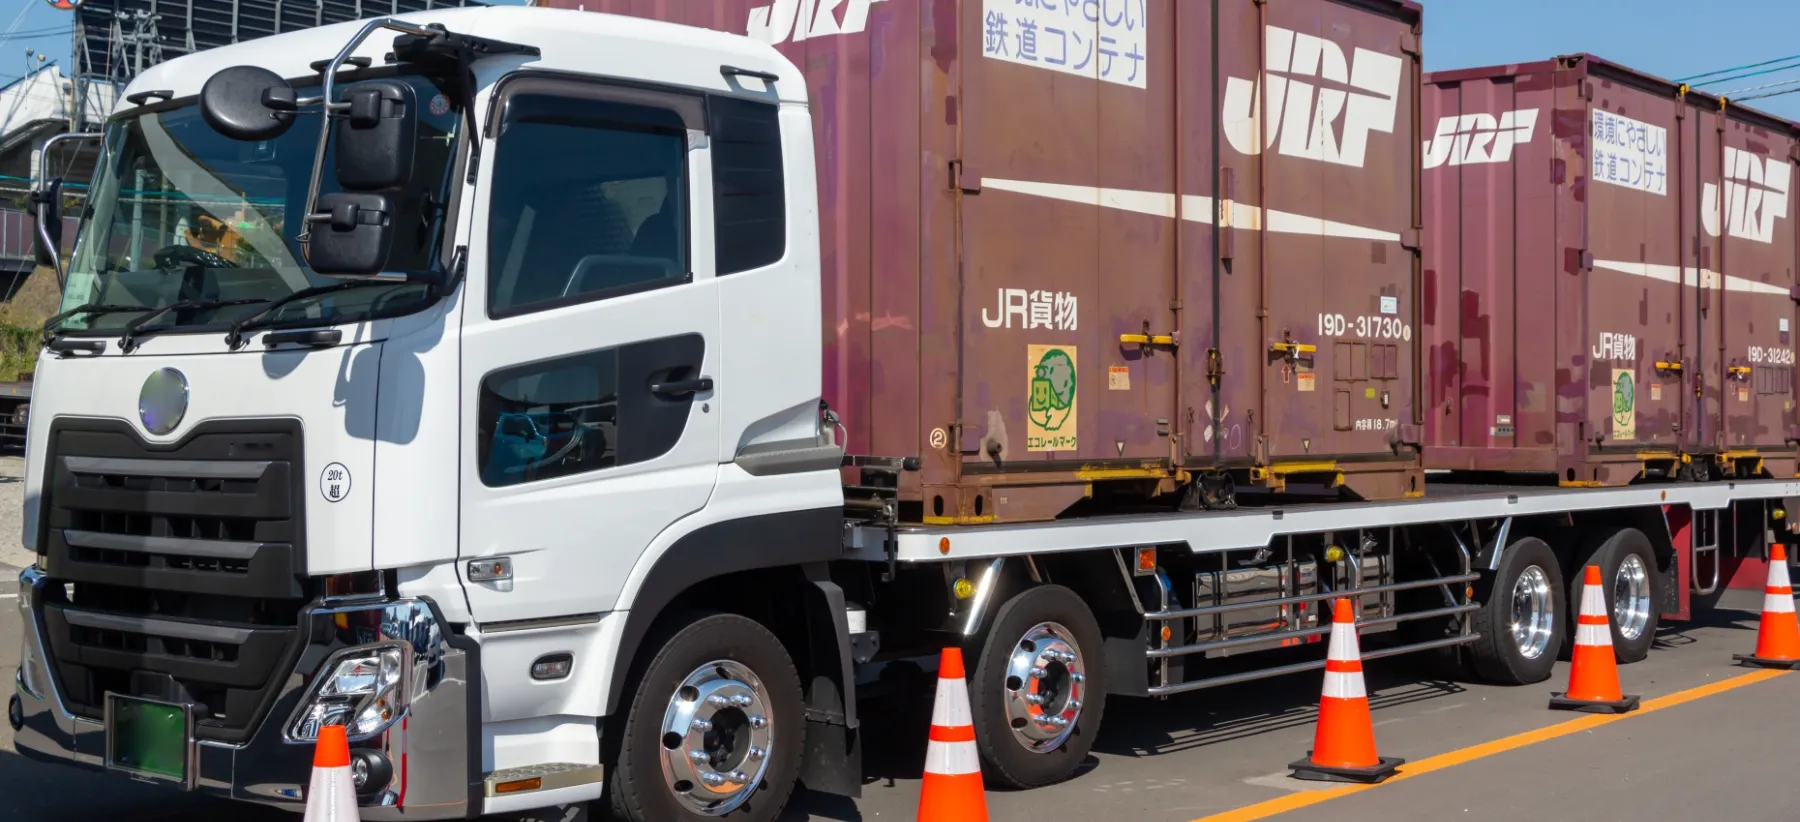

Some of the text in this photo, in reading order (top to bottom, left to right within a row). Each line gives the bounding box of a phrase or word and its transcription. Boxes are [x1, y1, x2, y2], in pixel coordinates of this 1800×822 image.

[985, 9, 1145, 82] 鉄道コンテナ
[1222, 24, 1403, 168] JRF
[1423, 108, 1539, 169] JRF
[1594, 111, 1666, 157] 環境にやさしい
[1594, 148, 1666, 191] 鉄道コンテナ
[1701, 146, 1791, 243] JRF
[982, 288, 1078, 331] JR貨物
[1318, 313, 1402, 339] 19D-31730
[1592, 332, 1635, 360] JR貨物
[1748, 346, 1791, 364] 19D-31242
[1028, 436, 1077, 448] エコレールマーク
[327, 469, 343, 481] 20t
[329, 484, 340, 498] 超
